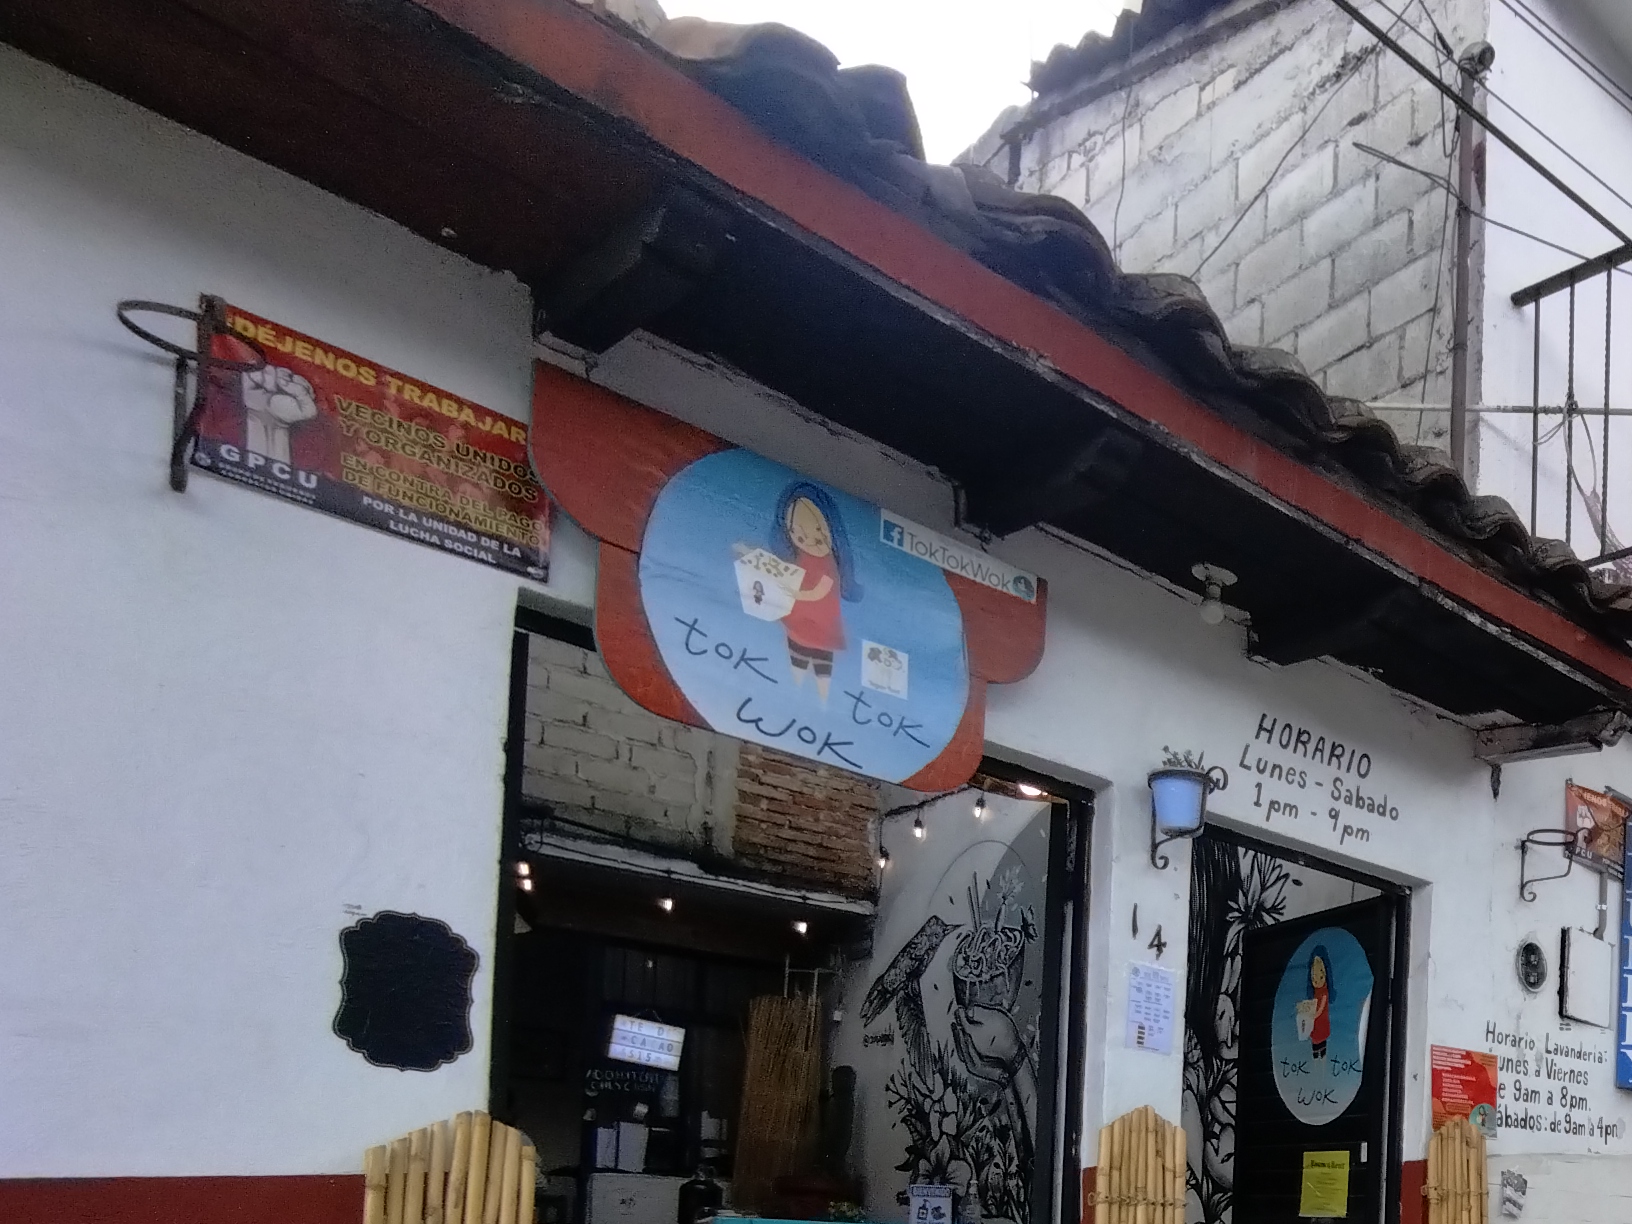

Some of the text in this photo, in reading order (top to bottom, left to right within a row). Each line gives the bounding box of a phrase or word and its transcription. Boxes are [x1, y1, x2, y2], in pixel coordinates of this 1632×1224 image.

[334, 394, 447, 449] VECINOS
[386, 375, 527, 445] TRABAJAR
[340, 417, 357, 437] Y
[365, 428, 539, 503] ORGANIZADOS
[341, 452, 545, 533] EN CONTRA DEL PAGO
[342, 469, 369, 489] DE
[372, 474, 542, 547] FUNCIONAMIENTO
[362, 495, 522, 558] POR LA UNIDAD DE LA
[389, 520, 497, 564] LUCHA SOCIAL
[906, 532, 1012, 592] TokTokWok
[1255, 713, 1371, 779] HORARIO
[1239, 743, 1307, 789] Lunes
[1330, 776, 1399, 821] Sabado
[1131, 903, 1167, 961] 14
[1485, 1020, 1535, 1051] Horario
[1498, 1056, 1529, 1078] unes
[1545, 1057, 1589, 1086] Viernes
[1513, 1079, 1540, 1104] 9am
[1546, 1090, 1553, 1106] a
[1496, 1104, 1548, 1132] ábados:
[1549, 1111, 1562, 1133] de
[1564, 1113, 1586, 1136] 9am
